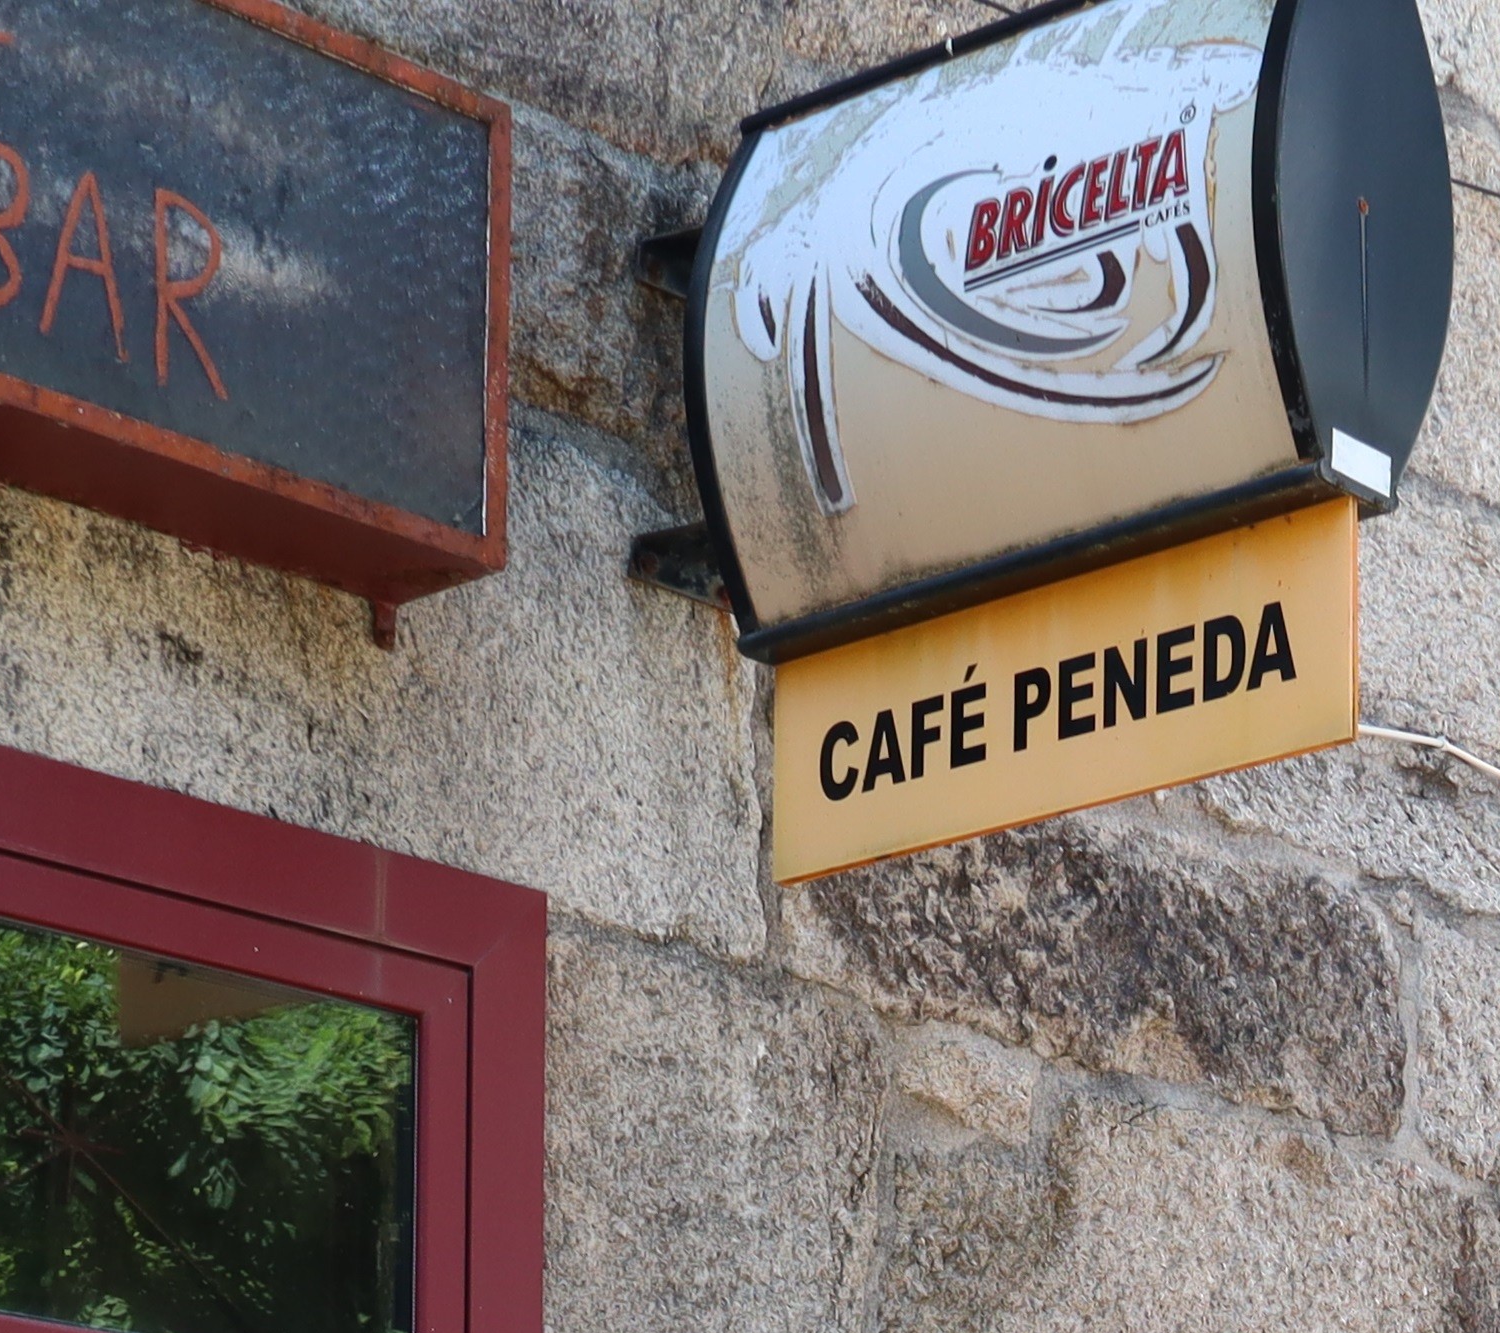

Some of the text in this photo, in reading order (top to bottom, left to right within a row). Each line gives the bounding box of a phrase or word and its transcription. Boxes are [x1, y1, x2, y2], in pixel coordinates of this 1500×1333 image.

[1143, 198, 1191, 228] CAFÉS
[819, 601, 1298, 802] CAFÉ PENEDA
